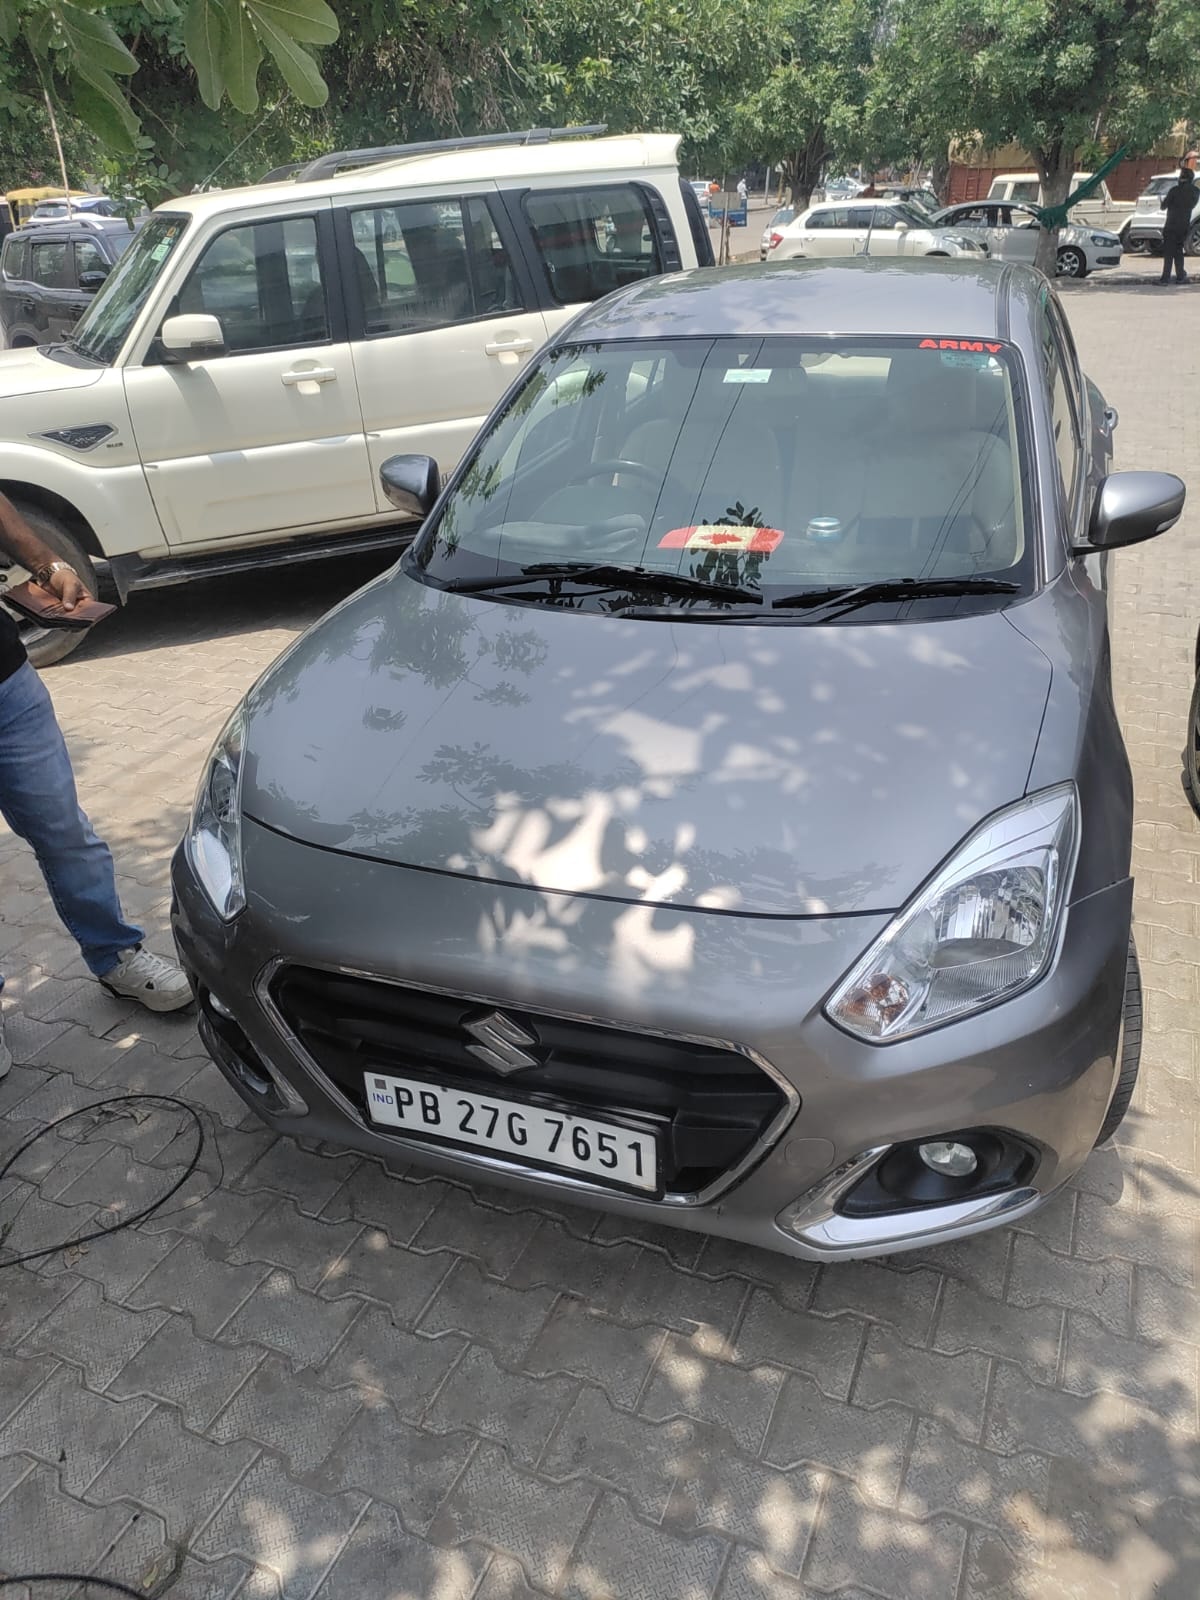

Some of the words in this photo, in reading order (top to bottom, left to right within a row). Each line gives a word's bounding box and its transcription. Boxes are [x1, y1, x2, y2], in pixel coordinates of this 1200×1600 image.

[919, 338, 1002, 353] ARMY
[372, 1092, 394, 1105] IND
[394, 1086, 441, 1125] PB
[457, 1099, 527, 1146] 27G
[544, 1118, 643, 1177] 7651
